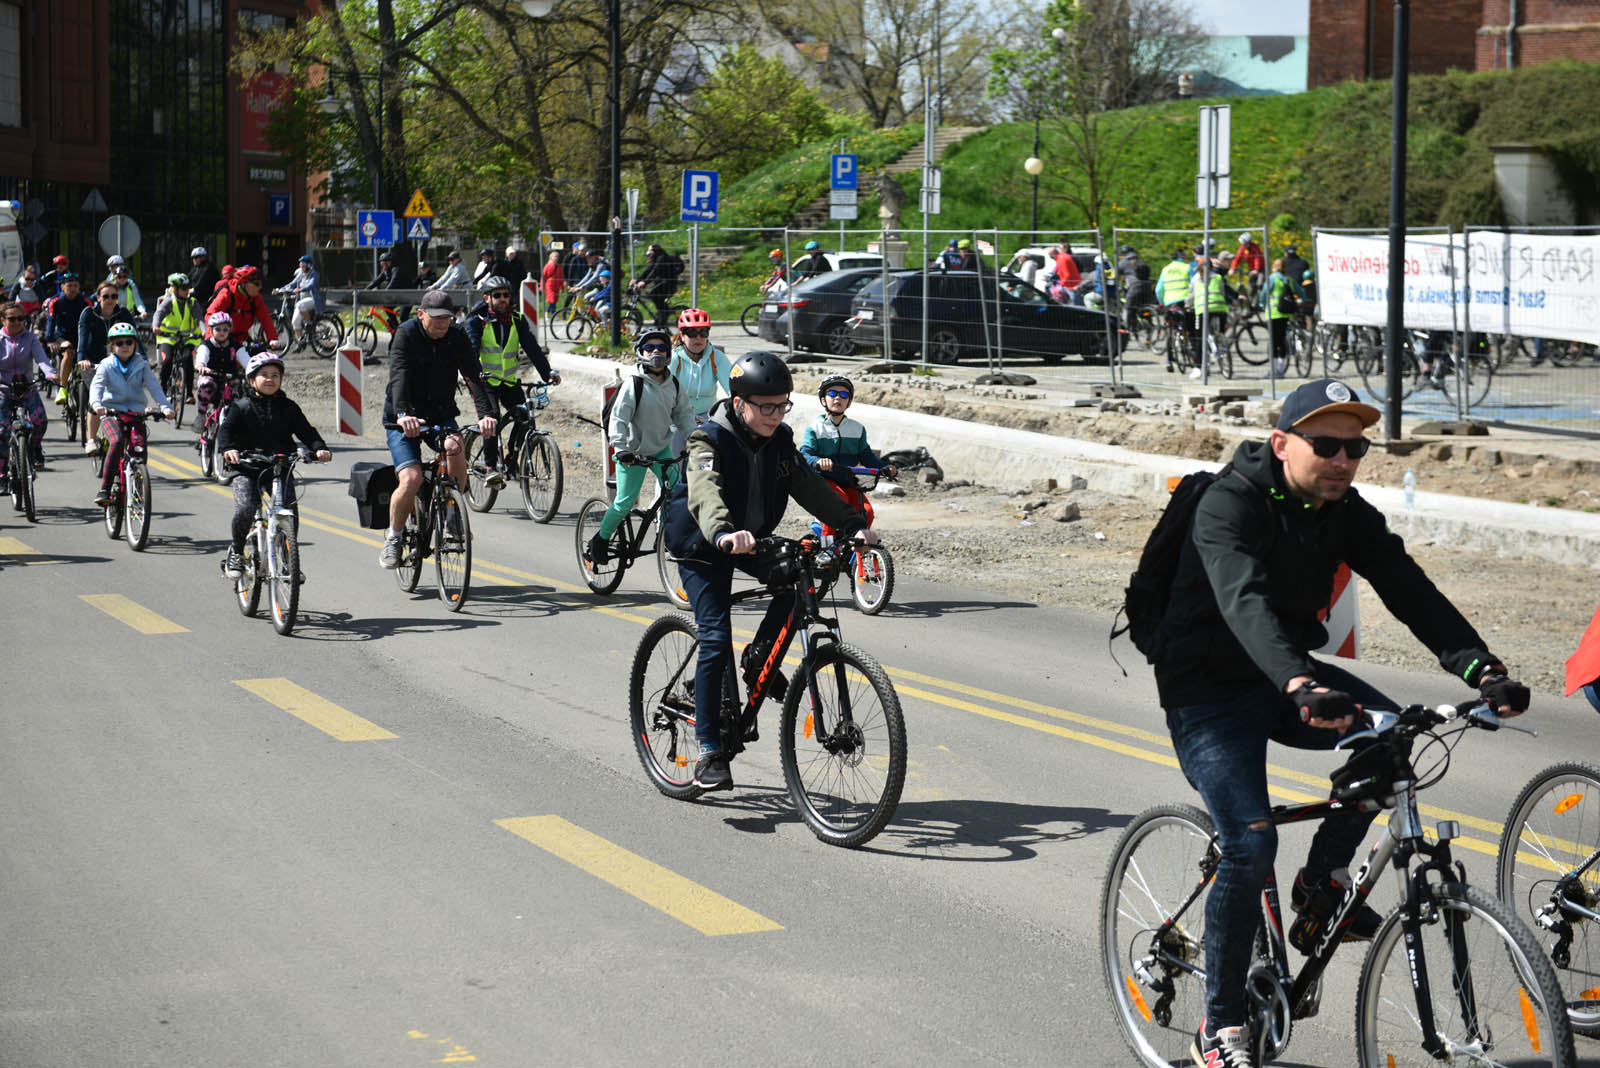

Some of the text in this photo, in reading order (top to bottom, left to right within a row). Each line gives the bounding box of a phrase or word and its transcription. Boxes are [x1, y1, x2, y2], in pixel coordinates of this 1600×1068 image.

[837, 157, 852, 179] P
[690, 174, 712, 207] P
[275, 200, 285, 216] P
